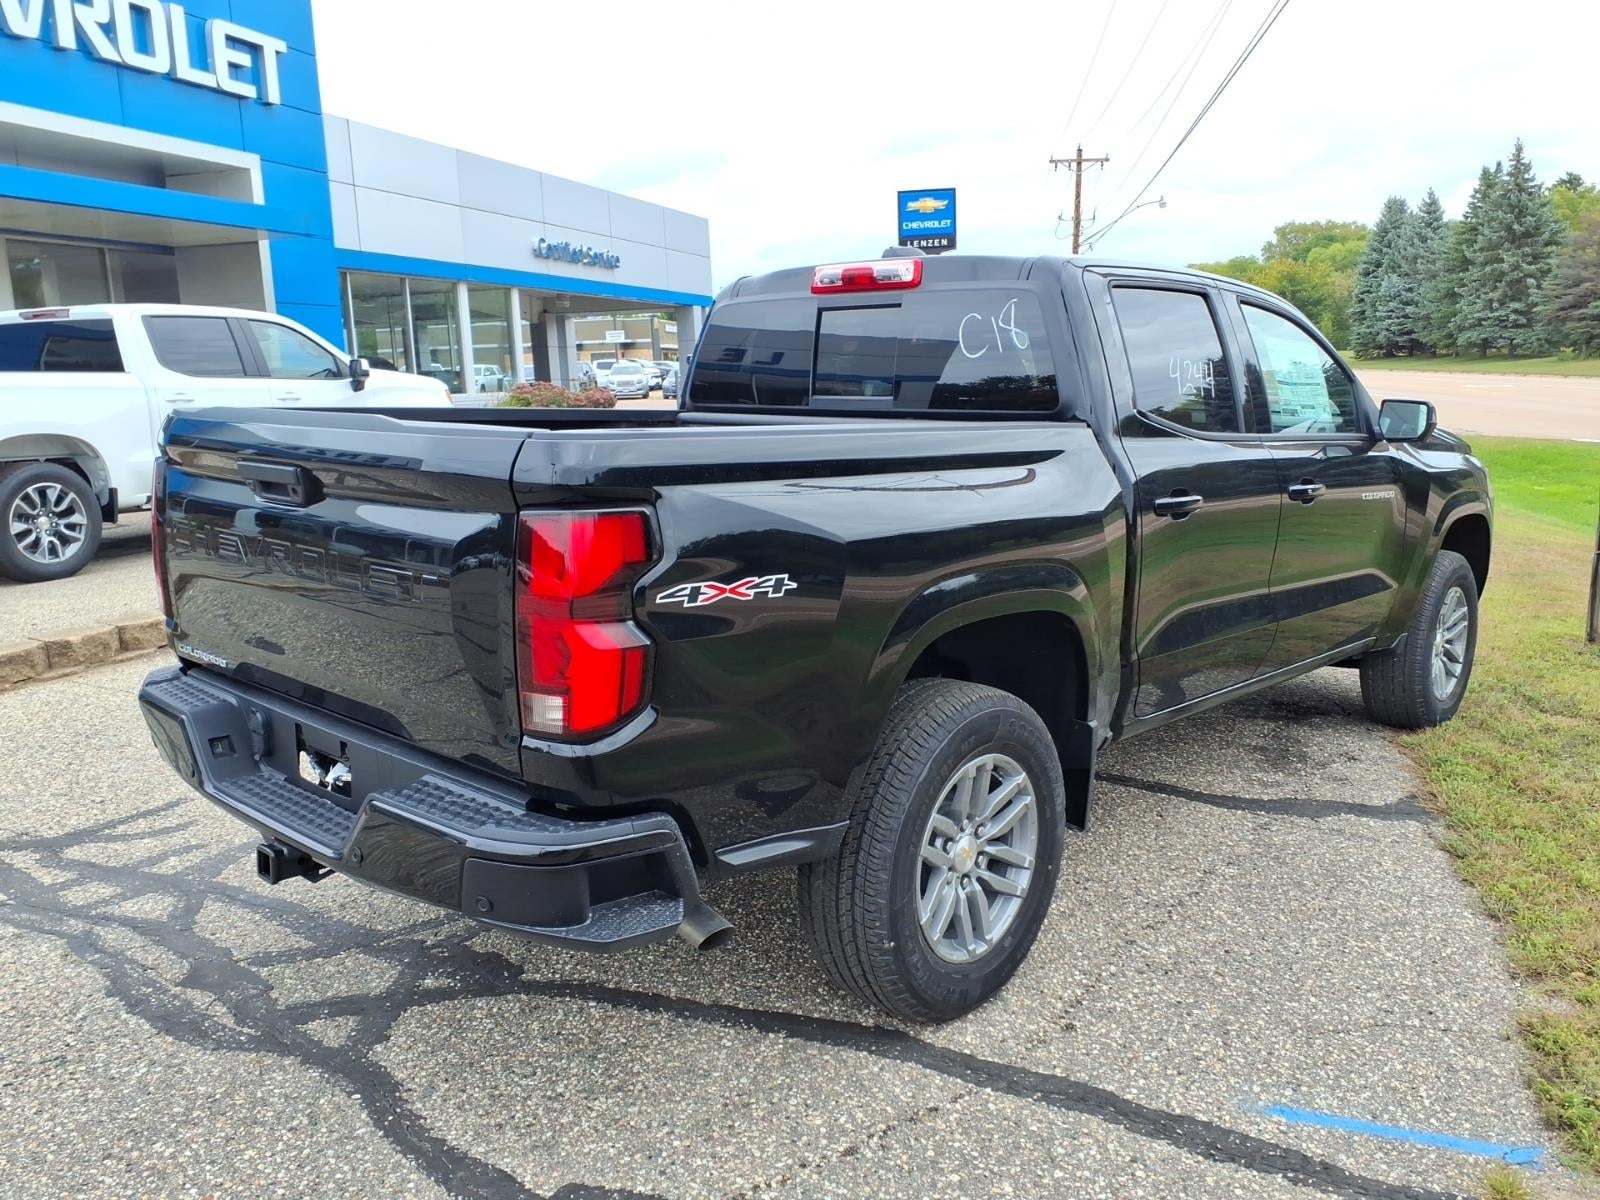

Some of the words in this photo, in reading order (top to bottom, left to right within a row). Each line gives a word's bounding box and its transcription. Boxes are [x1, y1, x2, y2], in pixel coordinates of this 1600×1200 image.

[903, 219, 952, 229] CHEVROLET
[907, 238, 948, 248] LENZEN
[583, 247, 620, 269] Service
[958, 298, 1028, 359] C18
[171, 517, 438, 602] CHEVROLET
[178, 643, 227, 668] COLORADO
